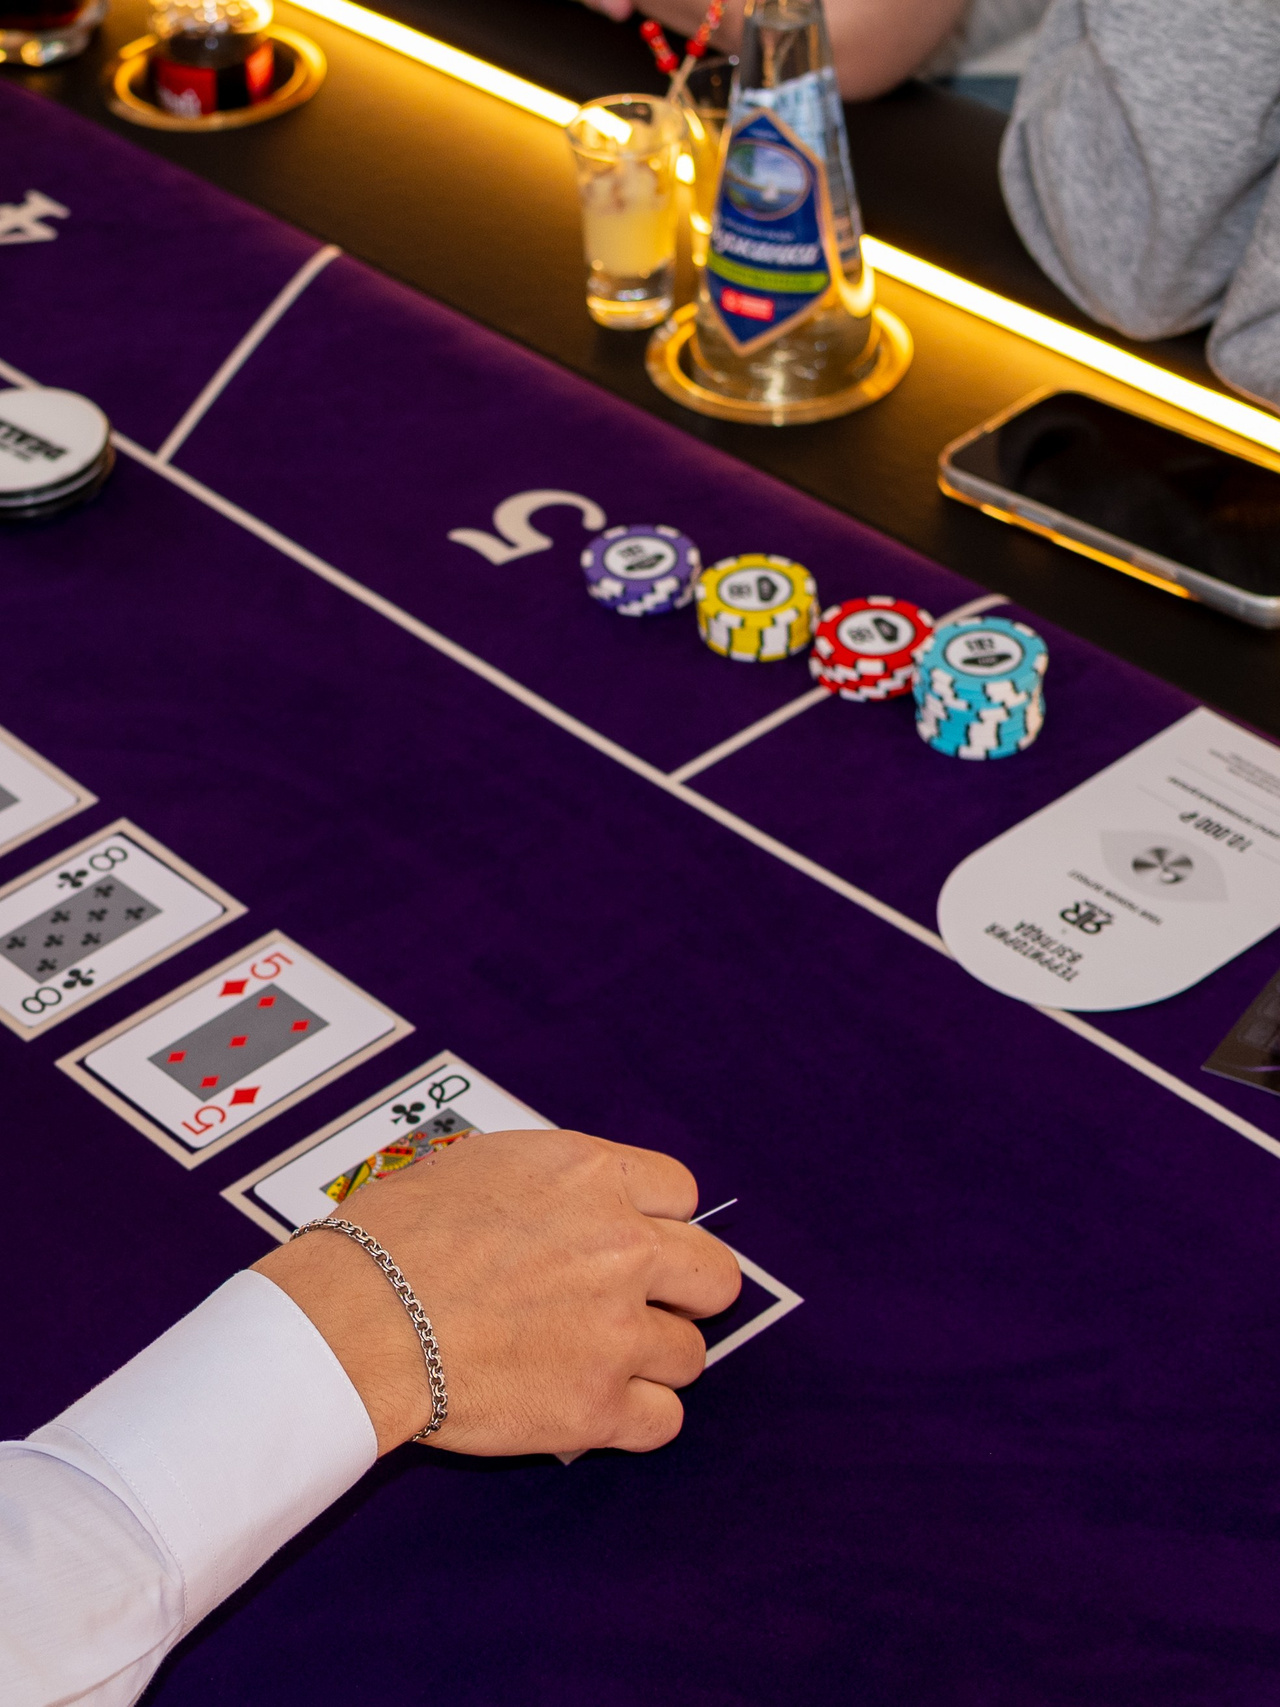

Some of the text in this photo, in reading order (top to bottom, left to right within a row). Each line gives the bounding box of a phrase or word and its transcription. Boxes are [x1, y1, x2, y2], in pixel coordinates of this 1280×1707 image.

[447, 489, 606, 566] 5
[88, 846, 129, 872] 8
[250, 952, 293, 980] 5
[21, 986, 62, 1014] 8
[427, 1074, 470, 1109] Q
[182, 1105, 227, 1136] 5
